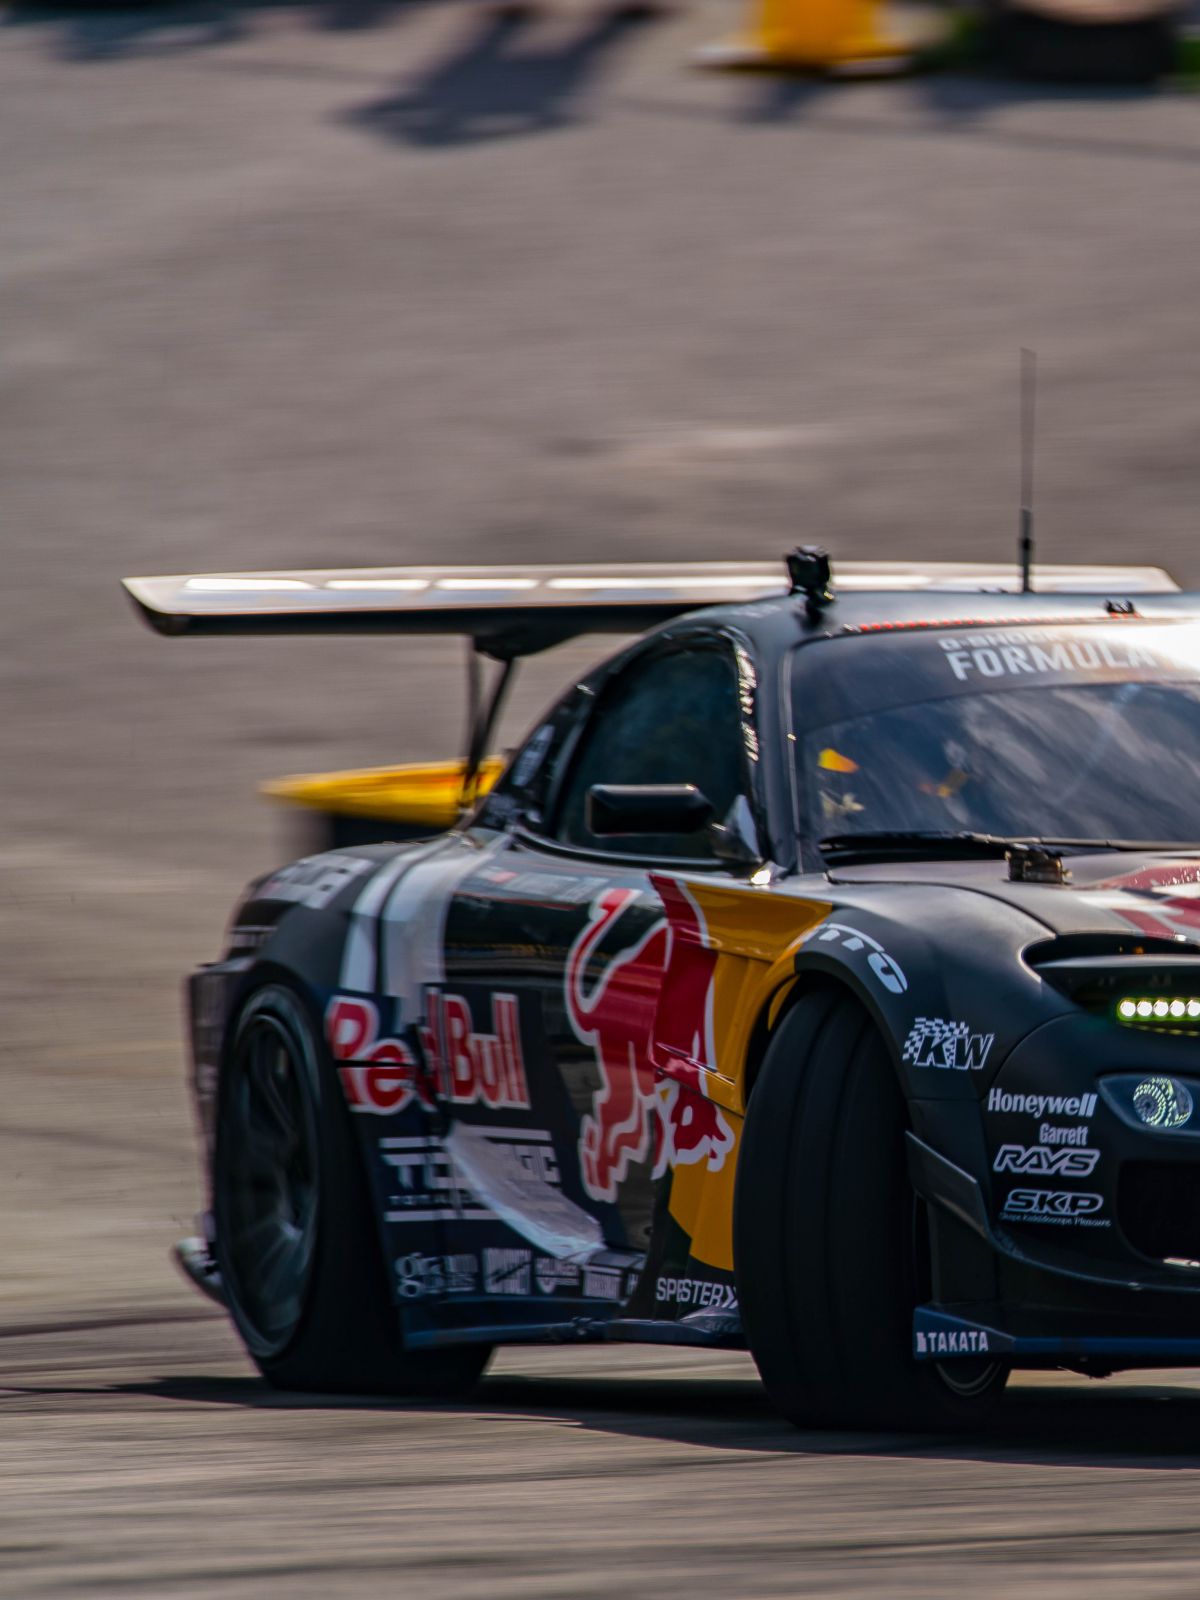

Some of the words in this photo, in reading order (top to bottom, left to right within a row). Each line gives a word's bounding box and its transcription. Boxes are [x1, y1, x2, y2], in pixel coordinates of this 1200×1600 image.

[944, 639, 1157, 681] FORMULA
[442, 991, 531, 1111] Bull
[912, 1032, 995, 1071] KW
[987, 1087, 1098, 1119] Honeywell
[1038, 1122, 1089, 1146] Garrett
[994, 1145, 1100, 1176] RAYS
[927, 1331, 989, 1353] TAKATA
